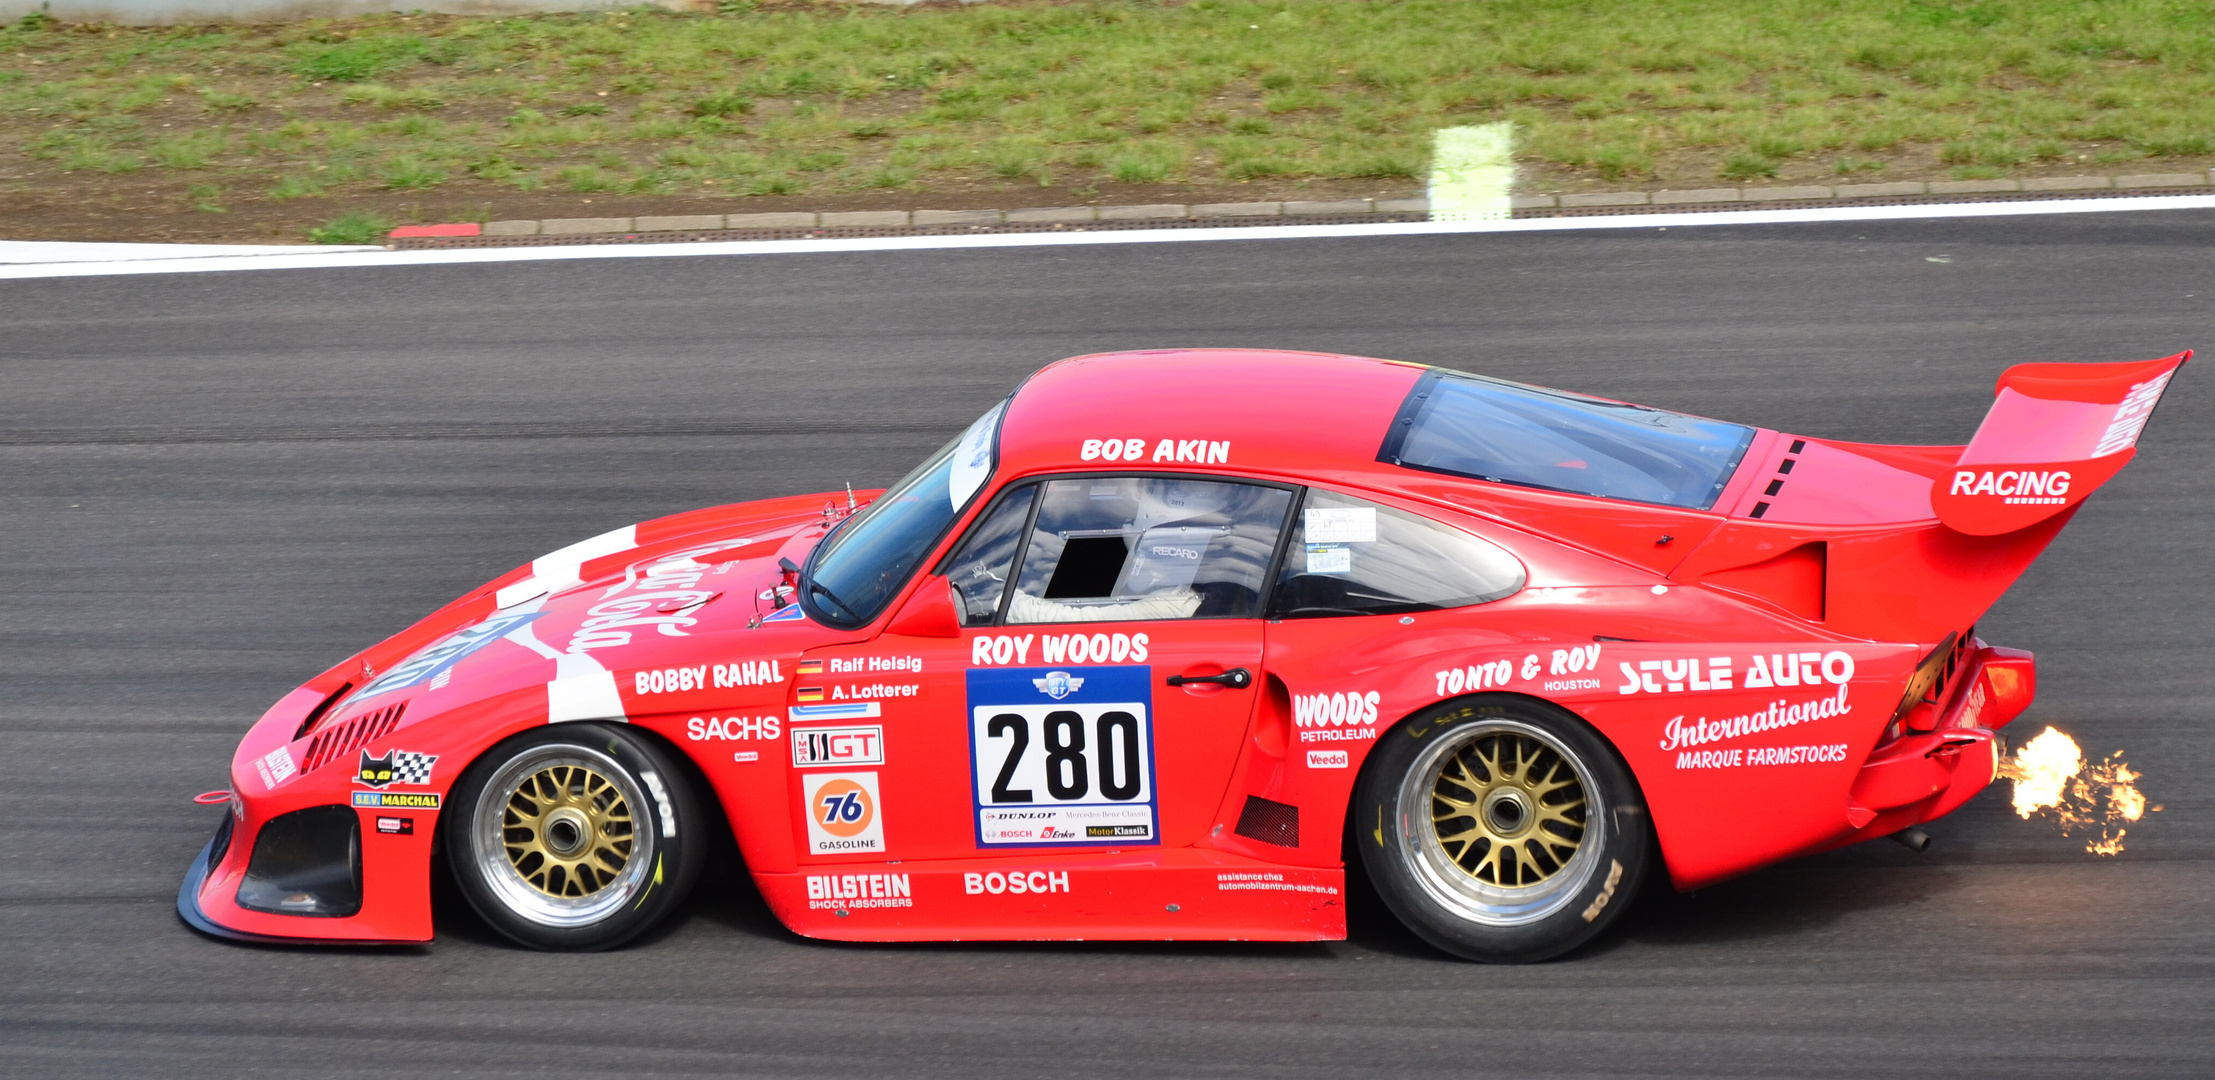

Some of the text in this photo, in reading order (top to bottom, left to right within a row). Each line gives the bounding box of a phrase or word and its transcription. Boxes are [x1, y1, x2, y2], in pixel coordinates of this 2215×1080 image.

[1080, 439, 1231, 464] BOB AKIN
[1950, 471, 2071, 495] RACING
[1152, 546, 1198, 560] RECARO
[973, 633, 1149, 666] ROY WOODS
[635, 660, 785, 695] BOBBY RAHAL
[830, 655, 923, 676] Ralf Heisig
[1435, 643, 1601, 697] TONTO & ROY
[1619, 651, 1855, 695] STYLE AUTO
[1544, 679, 1600, 692] HOUSTON
[1294, 690, 1381, 728] WOODS
[1660, 682, 1853, 751] International
[687, 716, 781, 741] SACHS
[1300, 728, 1376, 743] PETROLEUM
[830, 733, 876, 757] GT
[987, 710, 1141, 804] 280
[1675, 744, 1848, 770] MARQUE FARMSTOCKS
[1310, 754, 1345, 765] Veedol
[356, 795, 437, 807] S.E.V. MARCHAL
[824, 792, 862, 822] 76
[997, 812, 1056, 820] DUNLOP
[1122, 810, 1147, 818] Classic
[819, 840, 876, 850] GASOLINE
[1000, 830, 1033, 838] BOSCH
[1052, 830, 1075, 839] Enke
[806, 873, 911, 900] BILSTEIN
[964, 871, 1070, 895] BOSCH
[1217, 873, 1283, 881] assistance chez
[1219, 883, 1338, 895] automobilzentrum-aachen.de
[809, 898, 913, 910] SHOCK ABSORBERS
